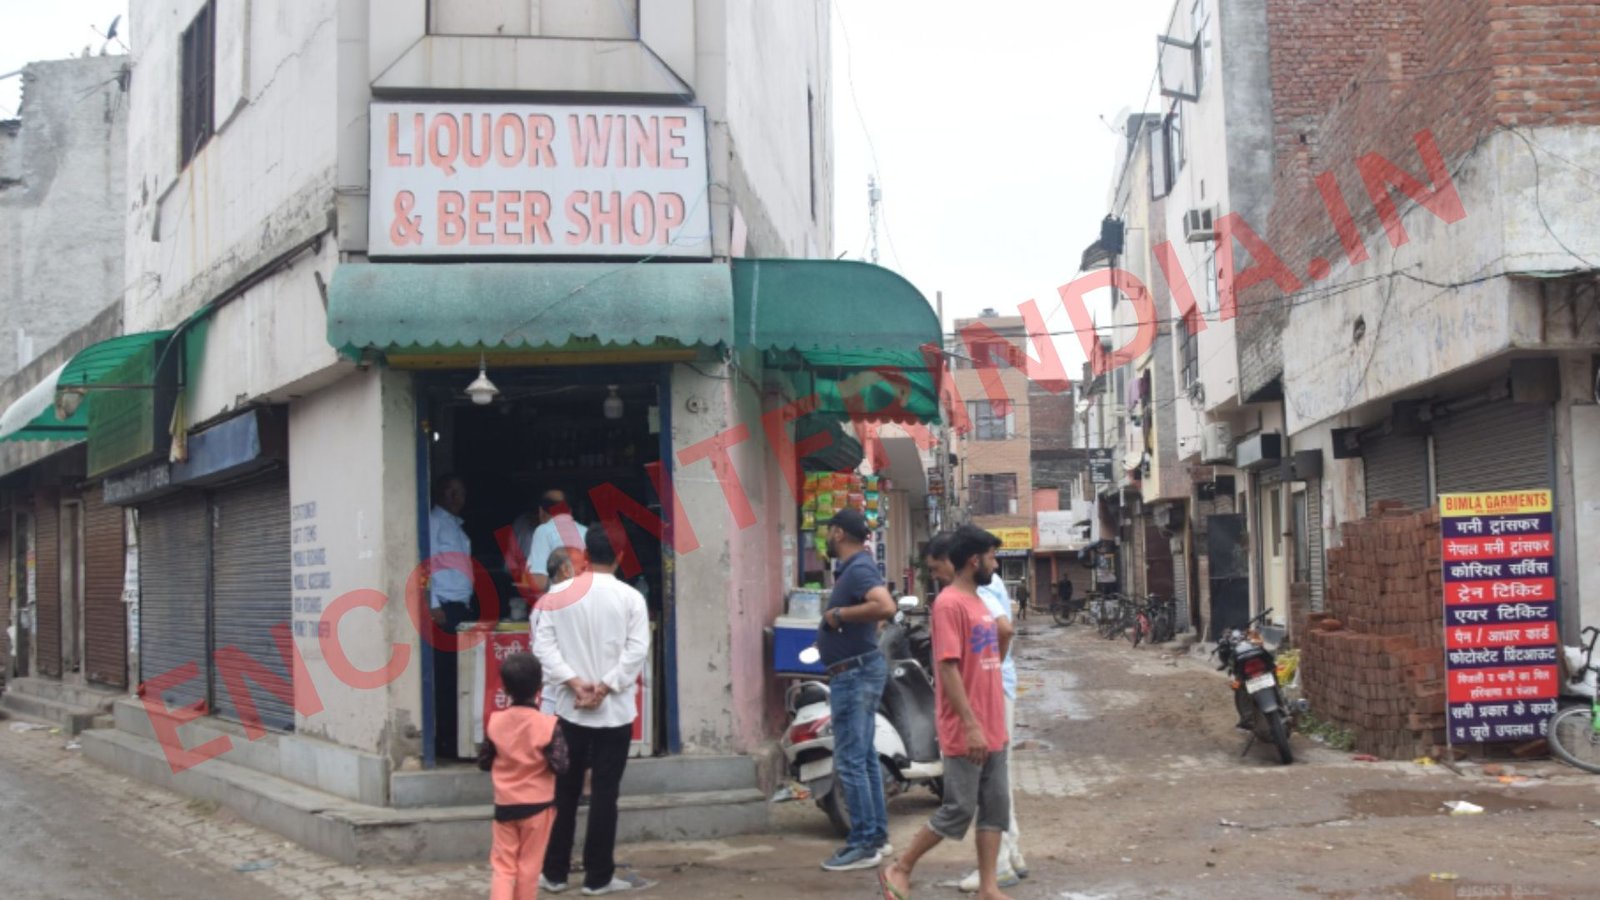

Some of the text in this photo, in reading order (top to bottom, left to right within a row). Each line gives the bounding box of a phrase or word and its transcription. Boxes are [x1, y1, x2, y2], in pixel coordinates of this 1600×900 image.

[387, 112, 689, 177] LIQUOR WINE
[389, 189, 686, 247] & BEER SHOP
[1446, 492, 1548, 510] BIMLA GARMENTS
[1456, 517, 1540, 535] मनी ट्रांसफर
[1448, 537, 1550, 557] नेपाल मनी ट्रांसफर
[1450, 558, 1548, 578] कोरियर सर्विस
[1458, 582, 1543, 602] ट्रेन टिकिट
[1455, 603, 1548, 624] एयर टिकिट
[1455, 628, 1471, 643] पैन
[1488, 629, 1520, 642] आधार
[1525, 624, 1550, 640] कार्ड
[1449, 647, 1499, 664] फोटोस्टेट
[1479, 705, 1509, 718] प्रकार
[1513, 700, 1525, 717] के
[1470, 722, 1490, 742] जूते
